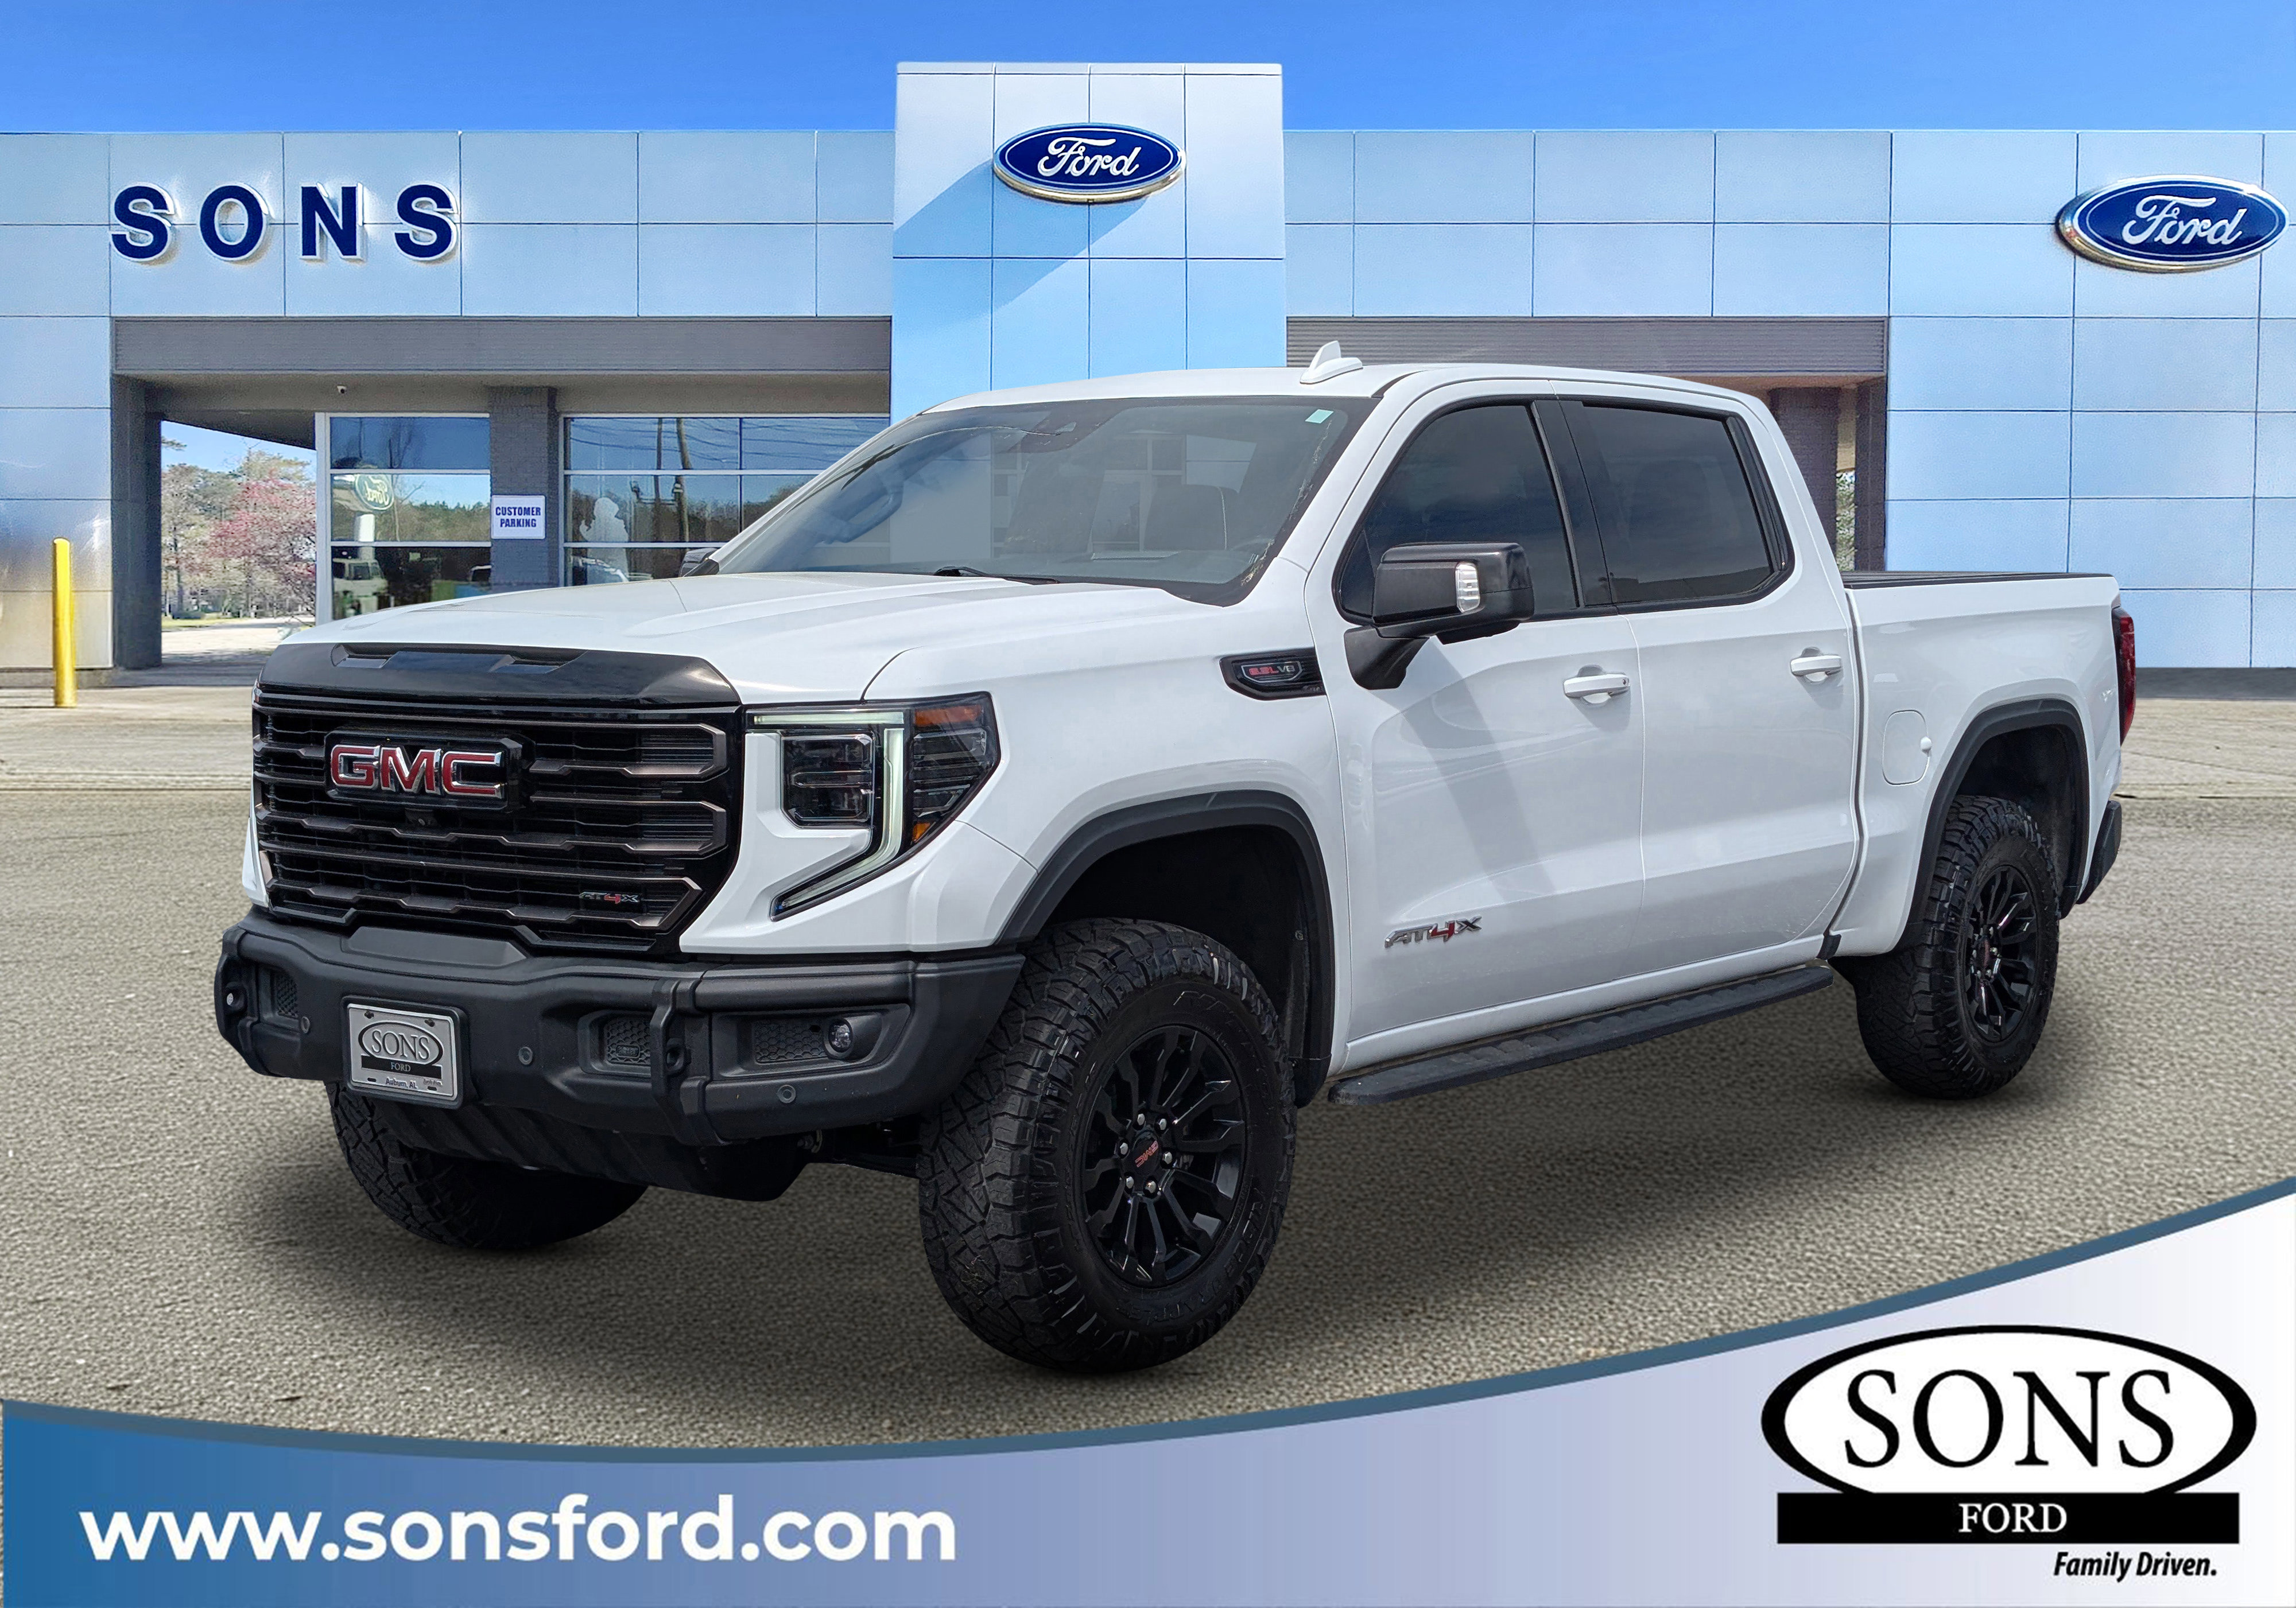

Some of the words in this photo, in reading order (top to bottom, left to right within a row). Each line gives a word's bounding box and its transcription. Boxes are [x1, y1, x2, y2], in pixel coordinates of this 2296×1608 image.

[1038, 137, 1141, 177] Ford
[111, 183, 458, 261] SONS
[2122, 195, 2248, 245] Ford
[495, 506, 541, 516] CUSTOMER
[500, 518, 537, 527] PARKING
[331, 744, 503, 799] GMC
[1384, 914, 1483, 948] AT4X
[371, 1029, 430, 1061] SONS
[390, 1062, 411, 1072] FORD
[1134, 1140, 1159, 1168] GMC
